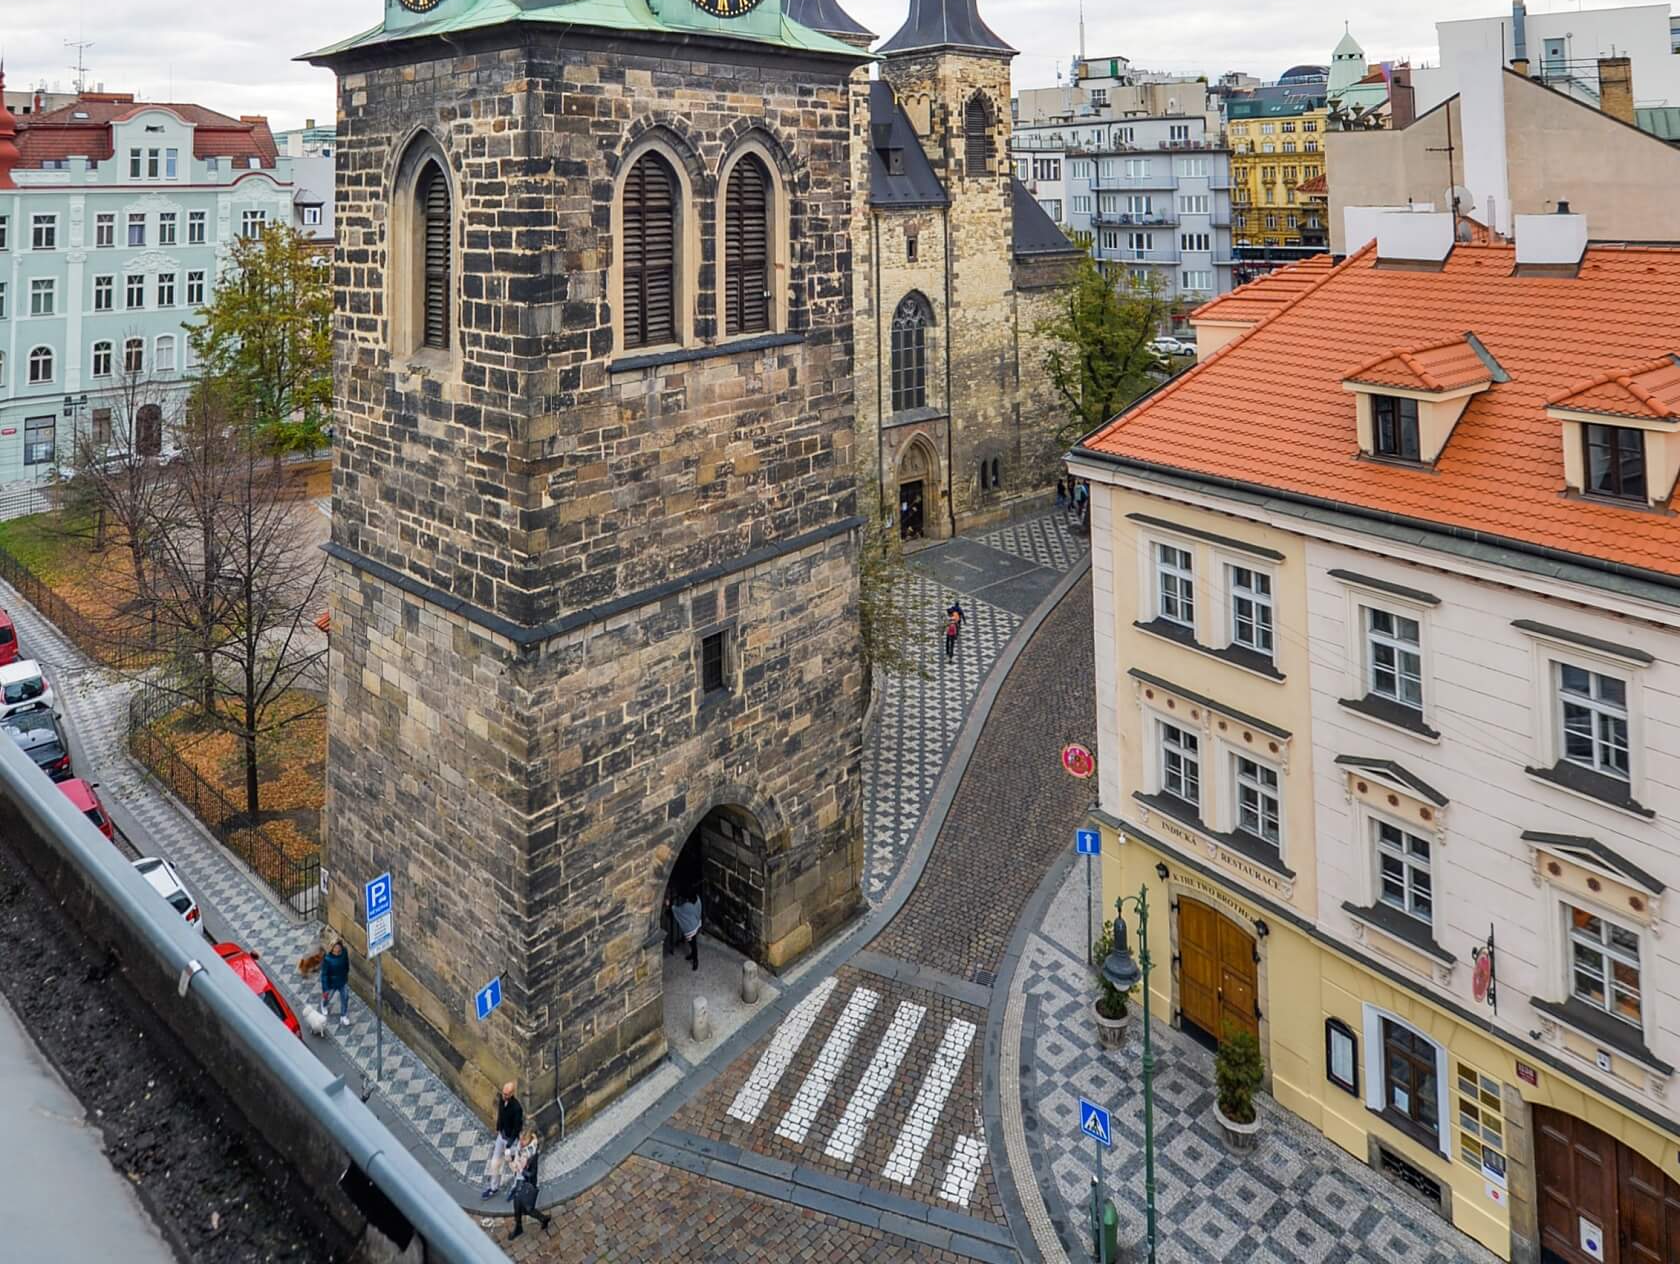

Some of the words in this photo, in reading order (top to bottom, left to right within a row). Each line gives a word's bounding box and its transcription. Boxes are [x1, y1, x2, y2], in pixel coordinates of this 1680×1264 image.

[1180, 875, 1196, 886] THE
[1196, 881, 1216, 895] TWO
[1220, 853, 1281, 891] RESTAURACE
[371, 882, 386, 908] P
